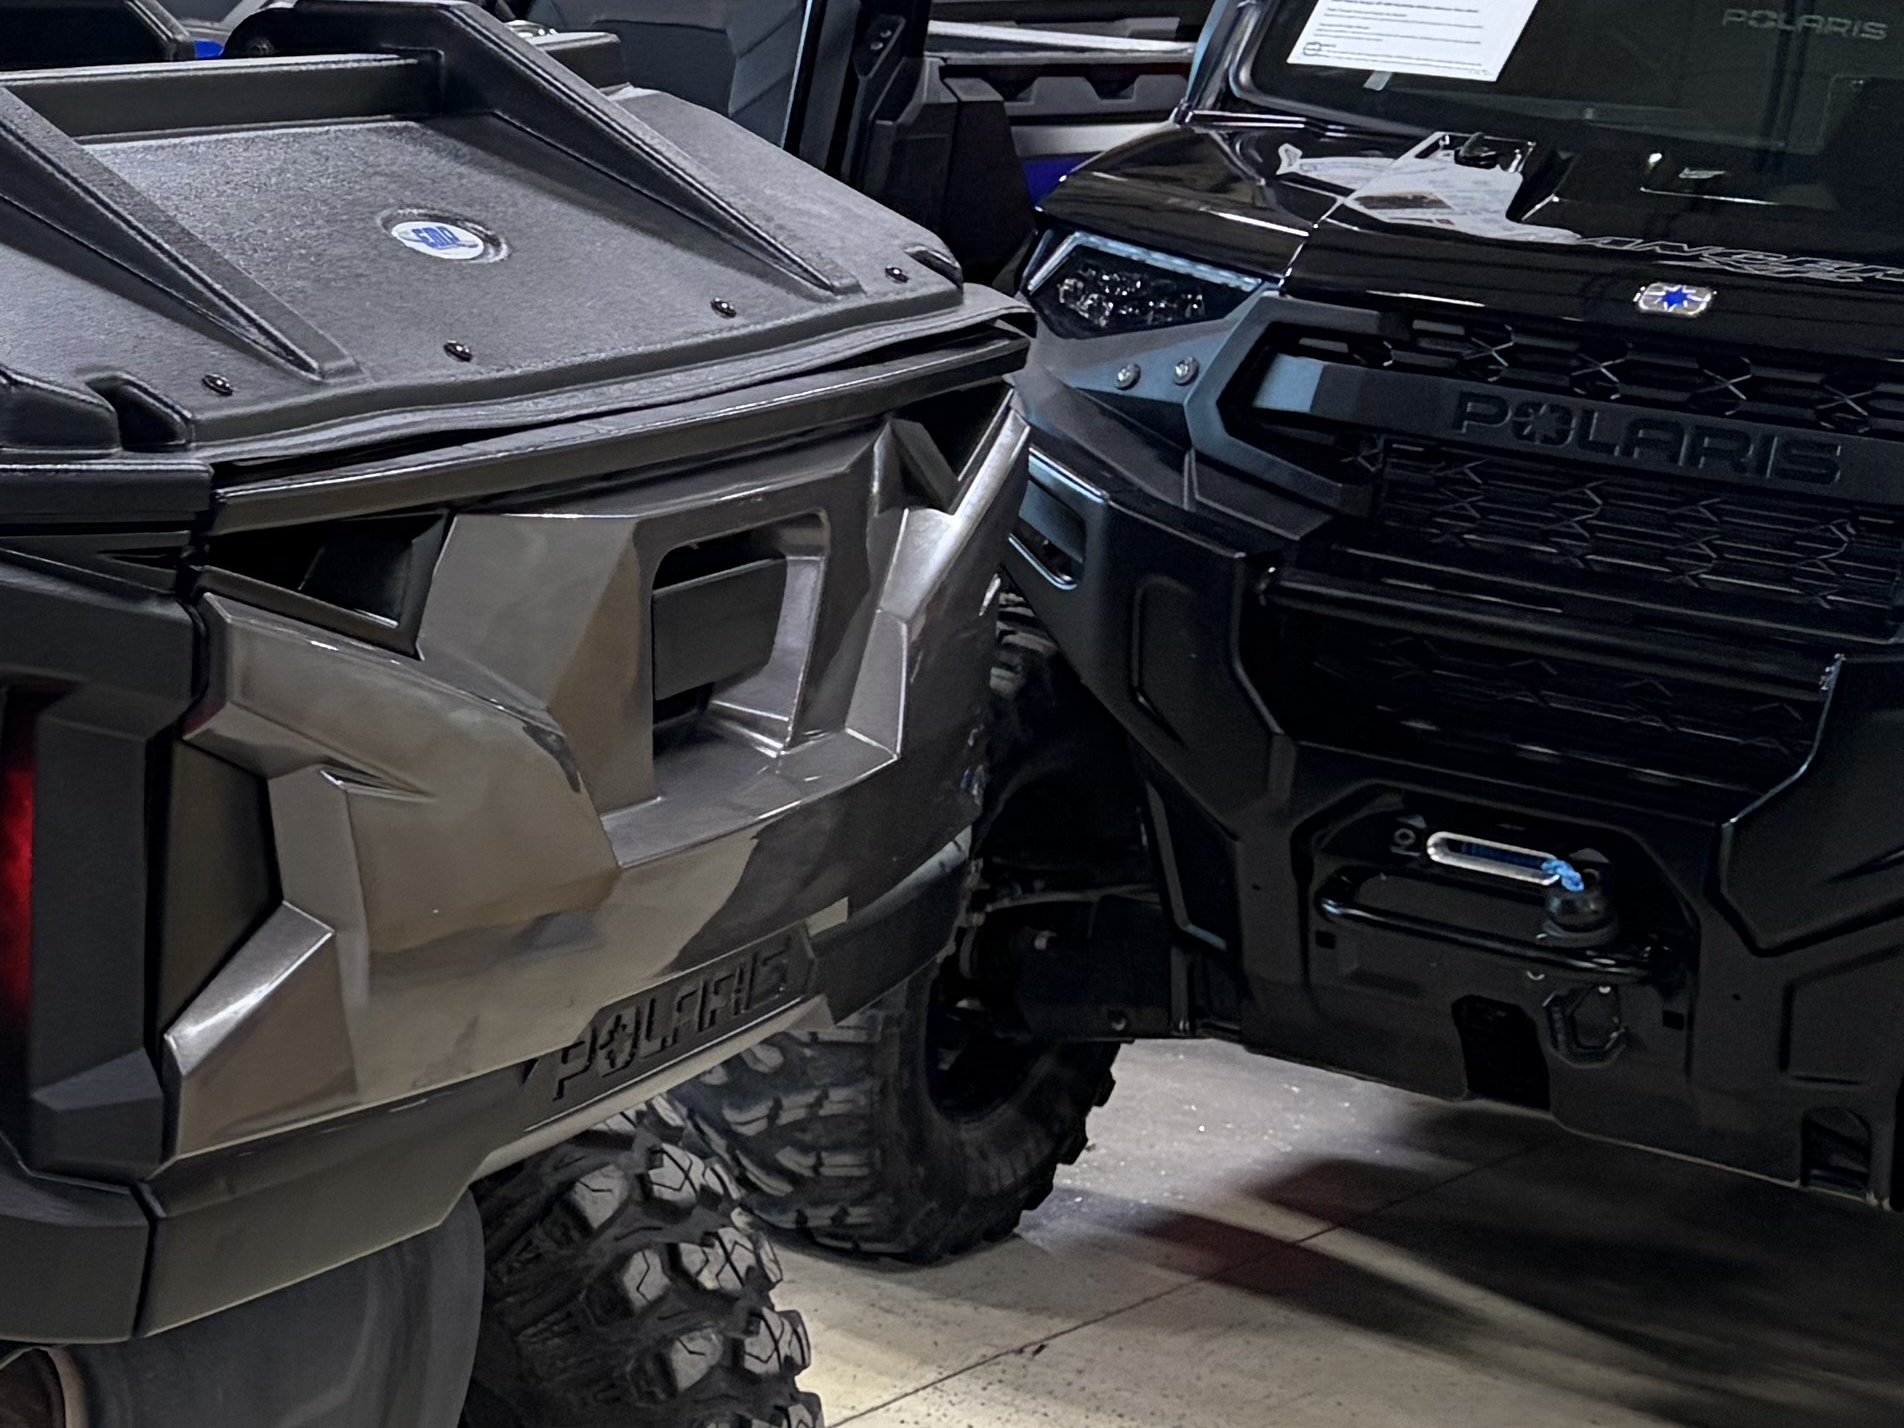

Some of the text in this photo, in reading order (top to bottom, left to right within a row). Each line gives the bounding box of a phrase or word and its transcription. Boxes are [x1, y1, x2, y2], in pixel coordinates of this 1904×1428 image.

[1722, 8, 1889, 41] POLARIS
[1452, 390, 1843, 486] POLARIS
[553, 935, 793, 1102] POLARIS
